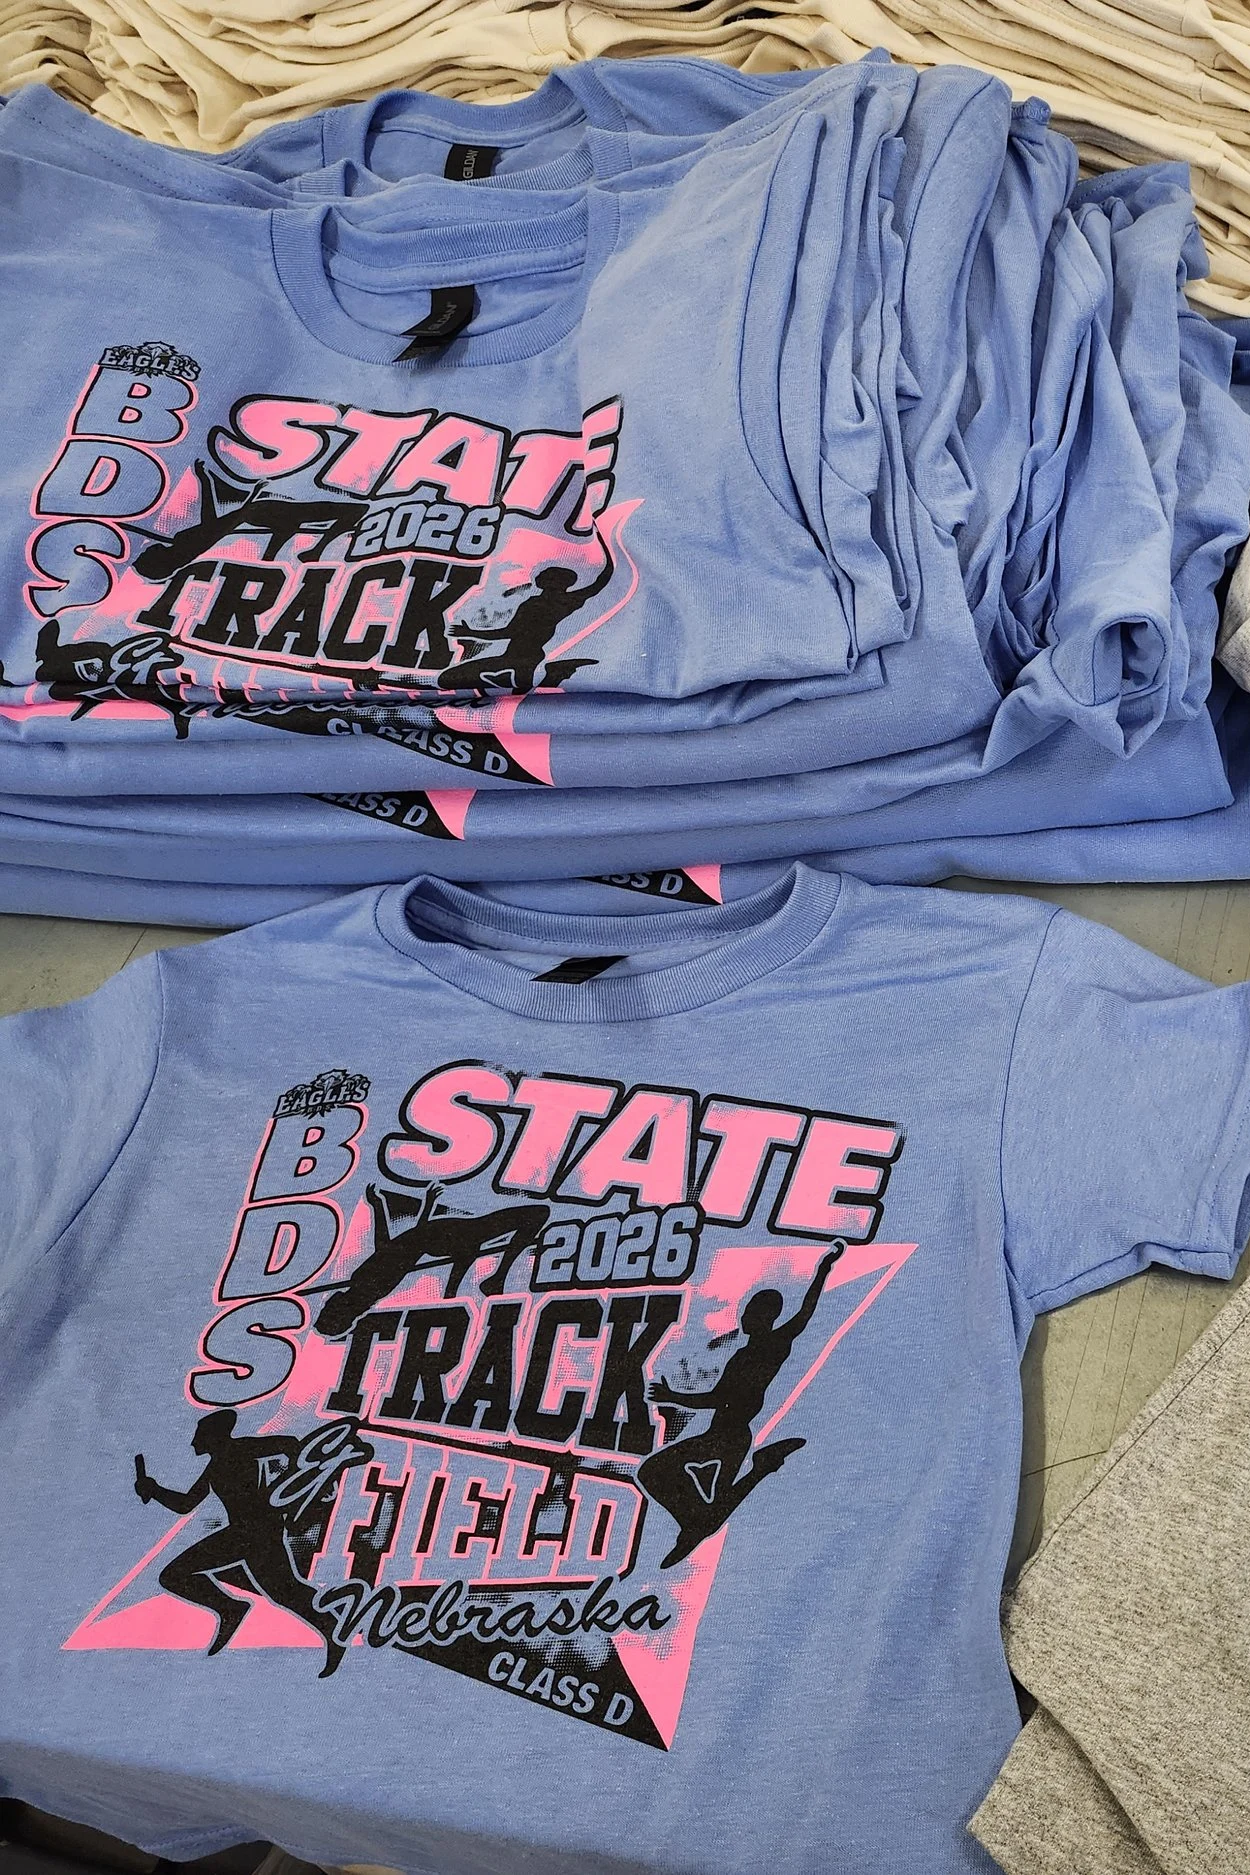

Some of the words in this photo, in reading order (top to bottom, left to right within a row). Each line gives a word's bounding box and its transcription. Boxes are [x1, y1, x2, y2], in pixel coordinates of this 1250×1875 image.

[349, 500, 502, 557] 2026
[134, 557, 488, 669] TRACK
[484, 751, 509, 774] D
[403, 805, 429, 827] D
[660, 873, 684, 895] D
[273, 1080, 371, 1118] EAGLES
[378, 1059, 906, 1243] STATE
[535, 1205, 702, 1292] 2026
[320, 1293, 684, 1455] TRACK
[309, 1429, 645, 1587] FIELD
[313, 1577, 672, 1648] Nebraska
[487, 1651, 600, 1714] CLASS
[603, 1694, 635, 1727] D
